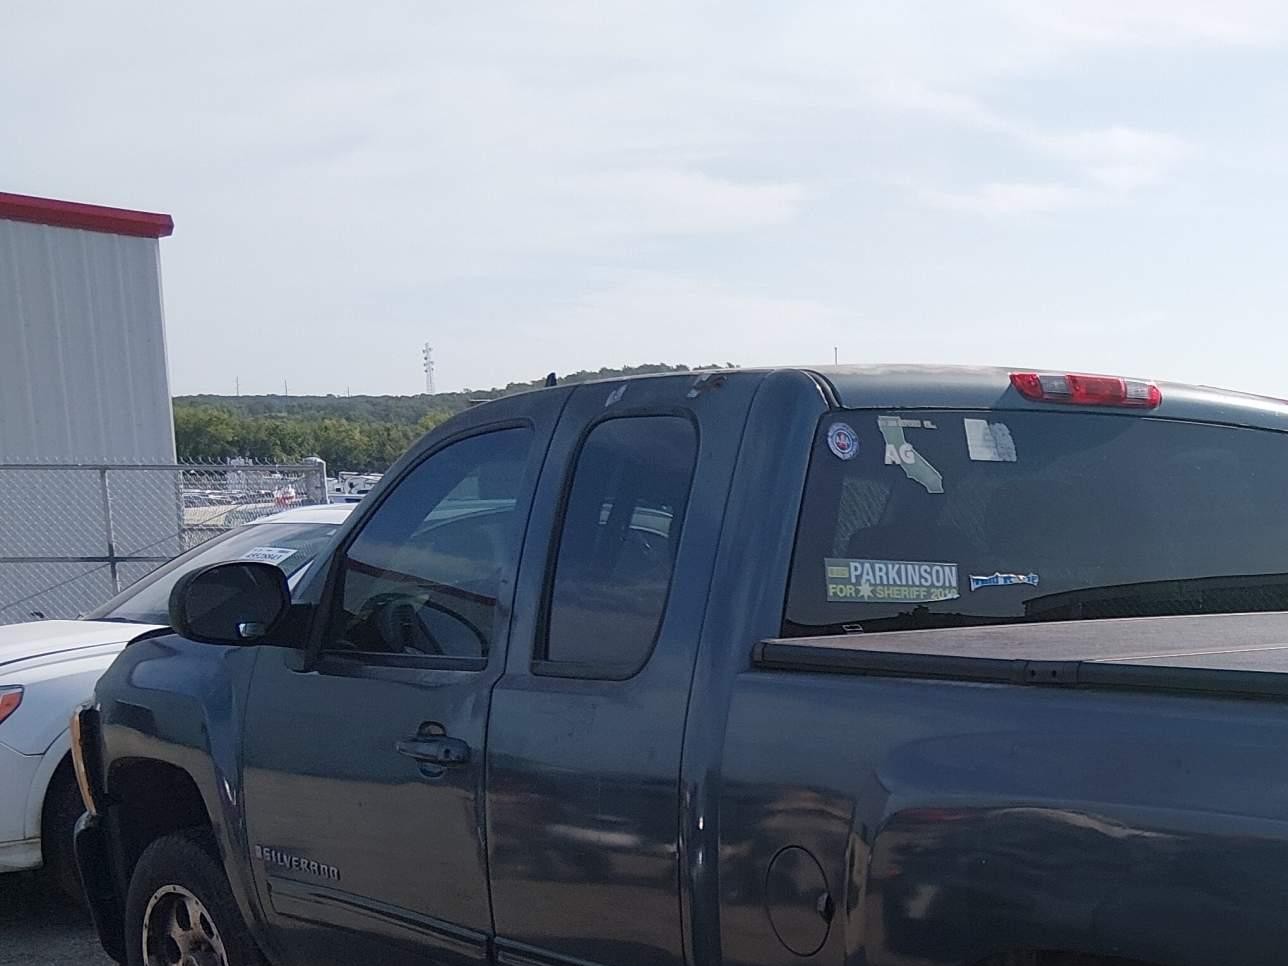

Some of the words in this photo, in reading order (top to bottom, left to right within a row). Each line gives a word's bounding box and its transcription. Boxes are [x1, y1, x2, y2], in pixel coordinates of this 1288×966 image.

[849, 562, 958, 587] PARKINSON
[828, 584, 856, 598] FOR
[875, 585, 928, 599] SHERIFF
[263, 847, 339, 880] SILVERADO
